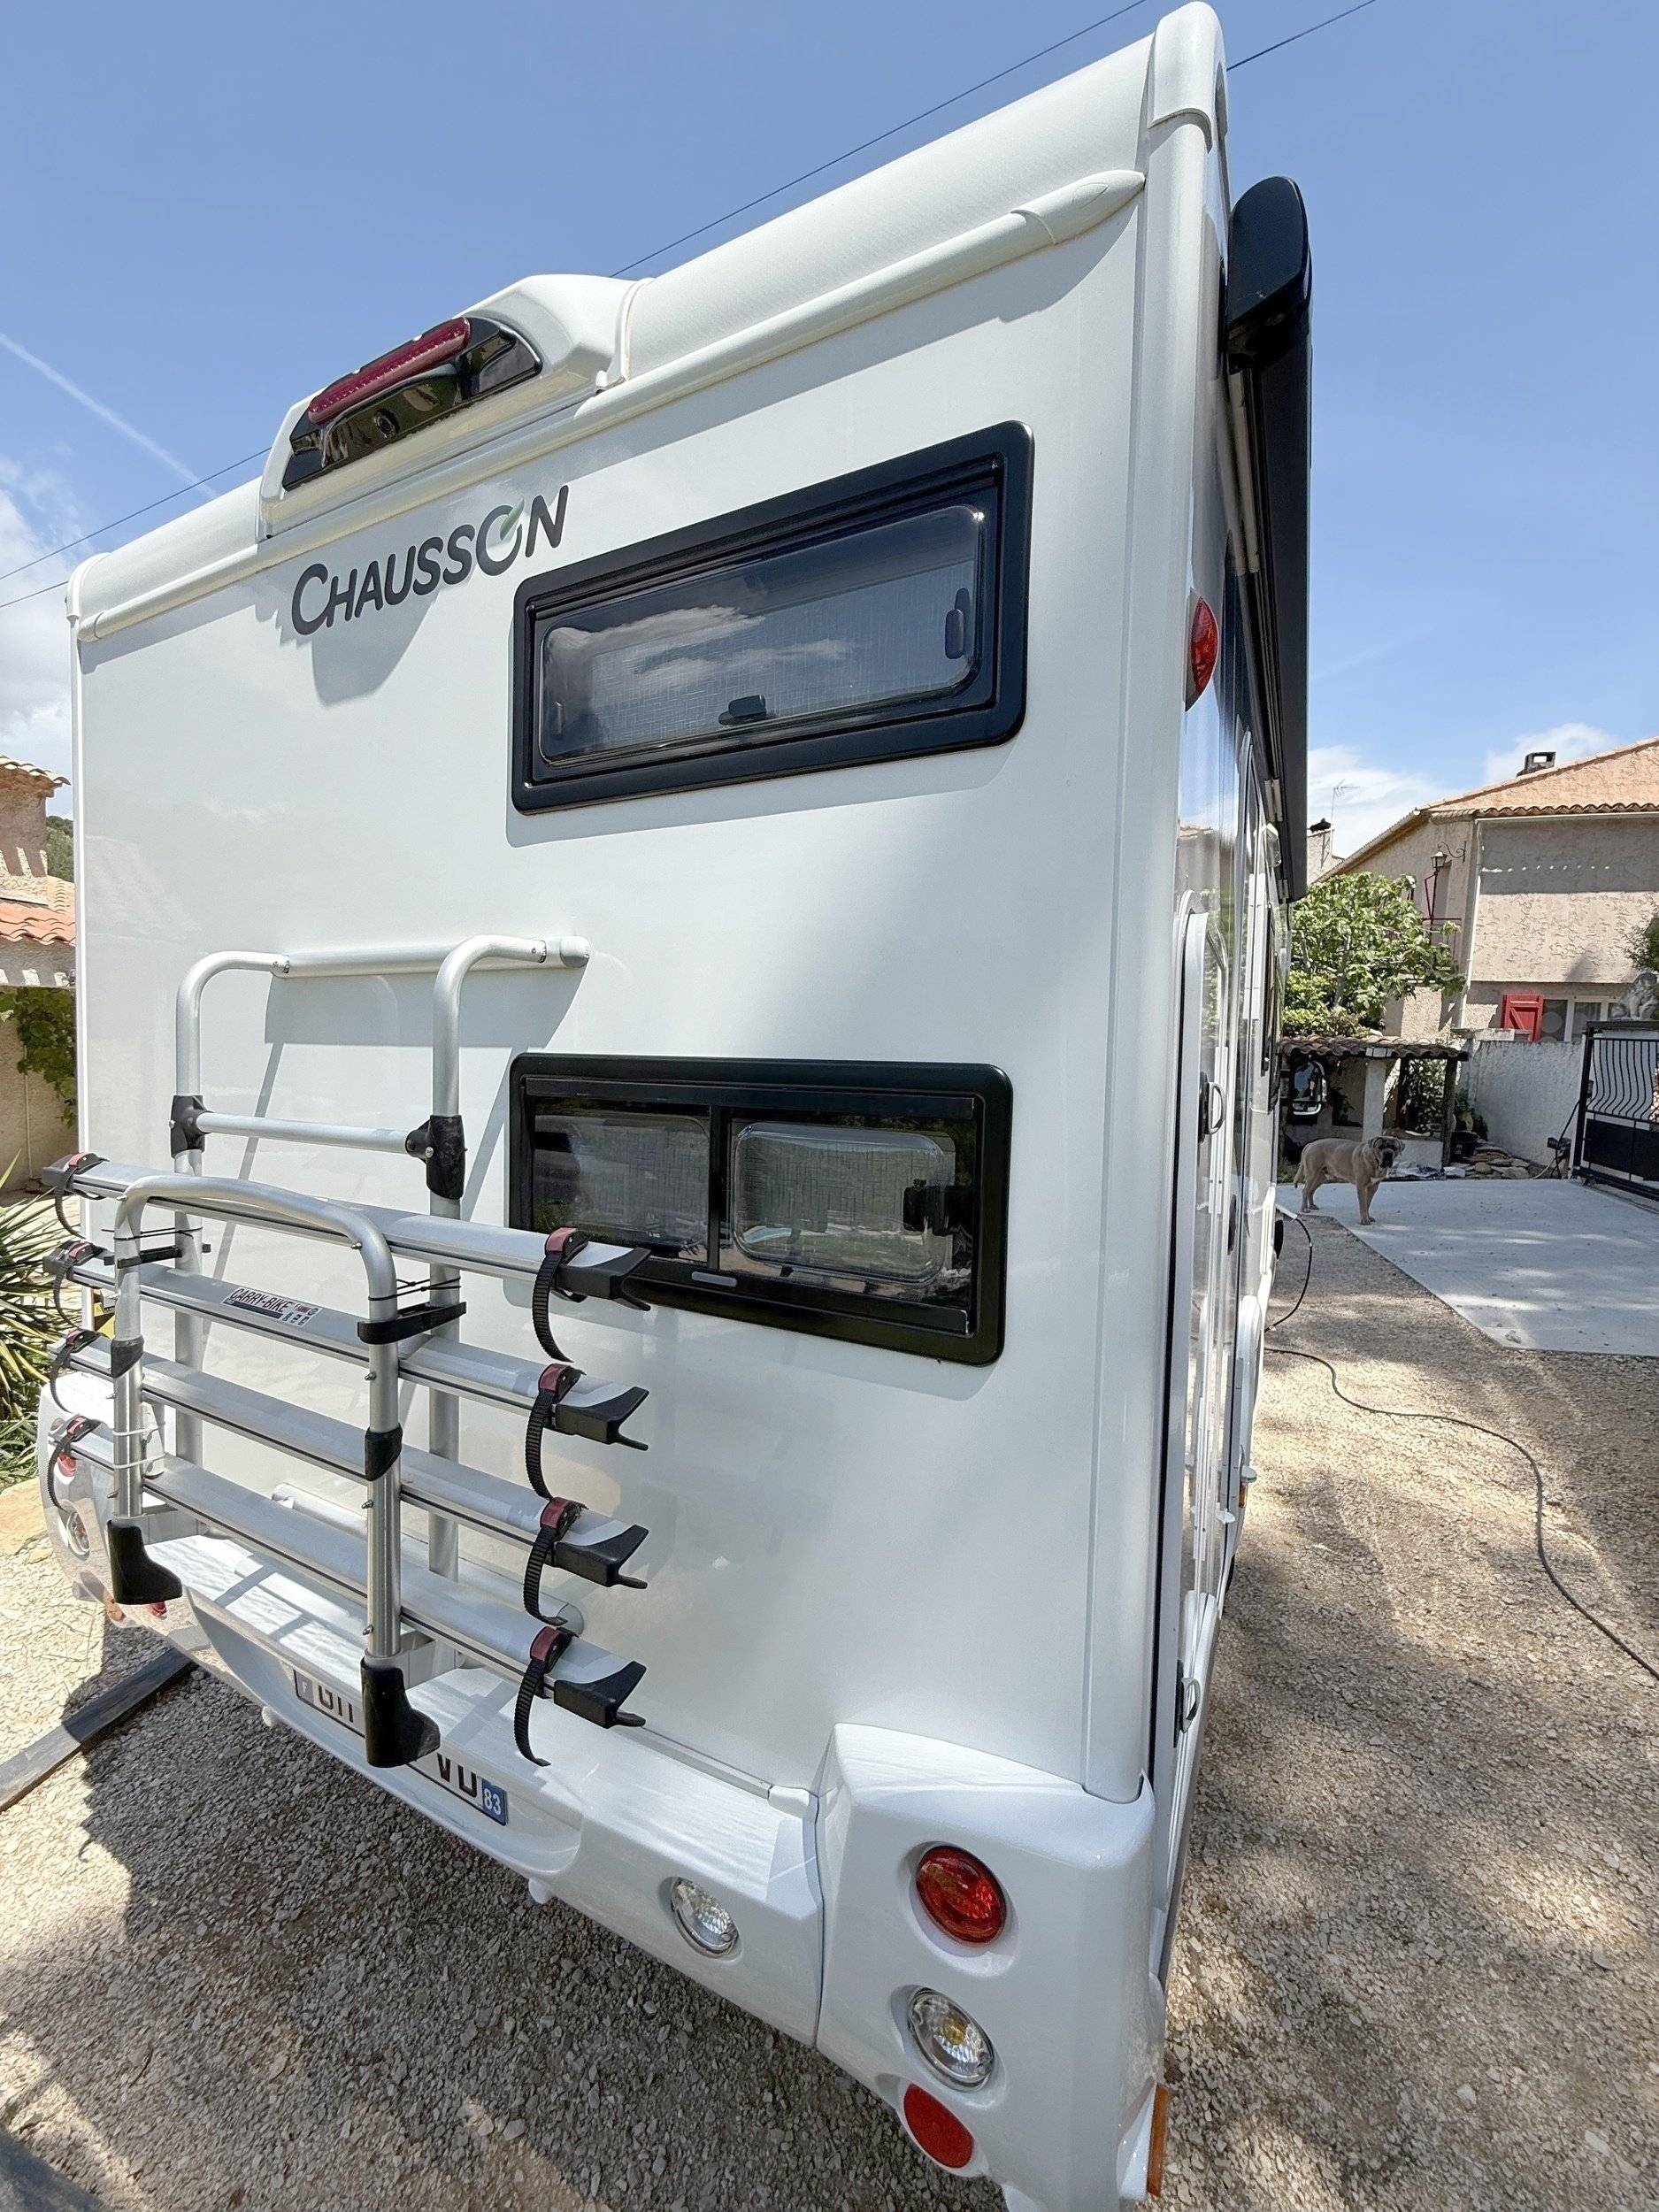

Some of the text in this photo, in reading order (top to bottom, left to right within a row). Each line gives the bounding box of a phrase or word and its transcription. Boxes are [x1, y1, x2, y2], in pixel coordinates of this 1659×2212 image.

[291, 484, 570, 636] CHAUSSON
[230, 1287, 293, 1313] CARRY-BIKE
[483, 1787, 502, 1816] 83
